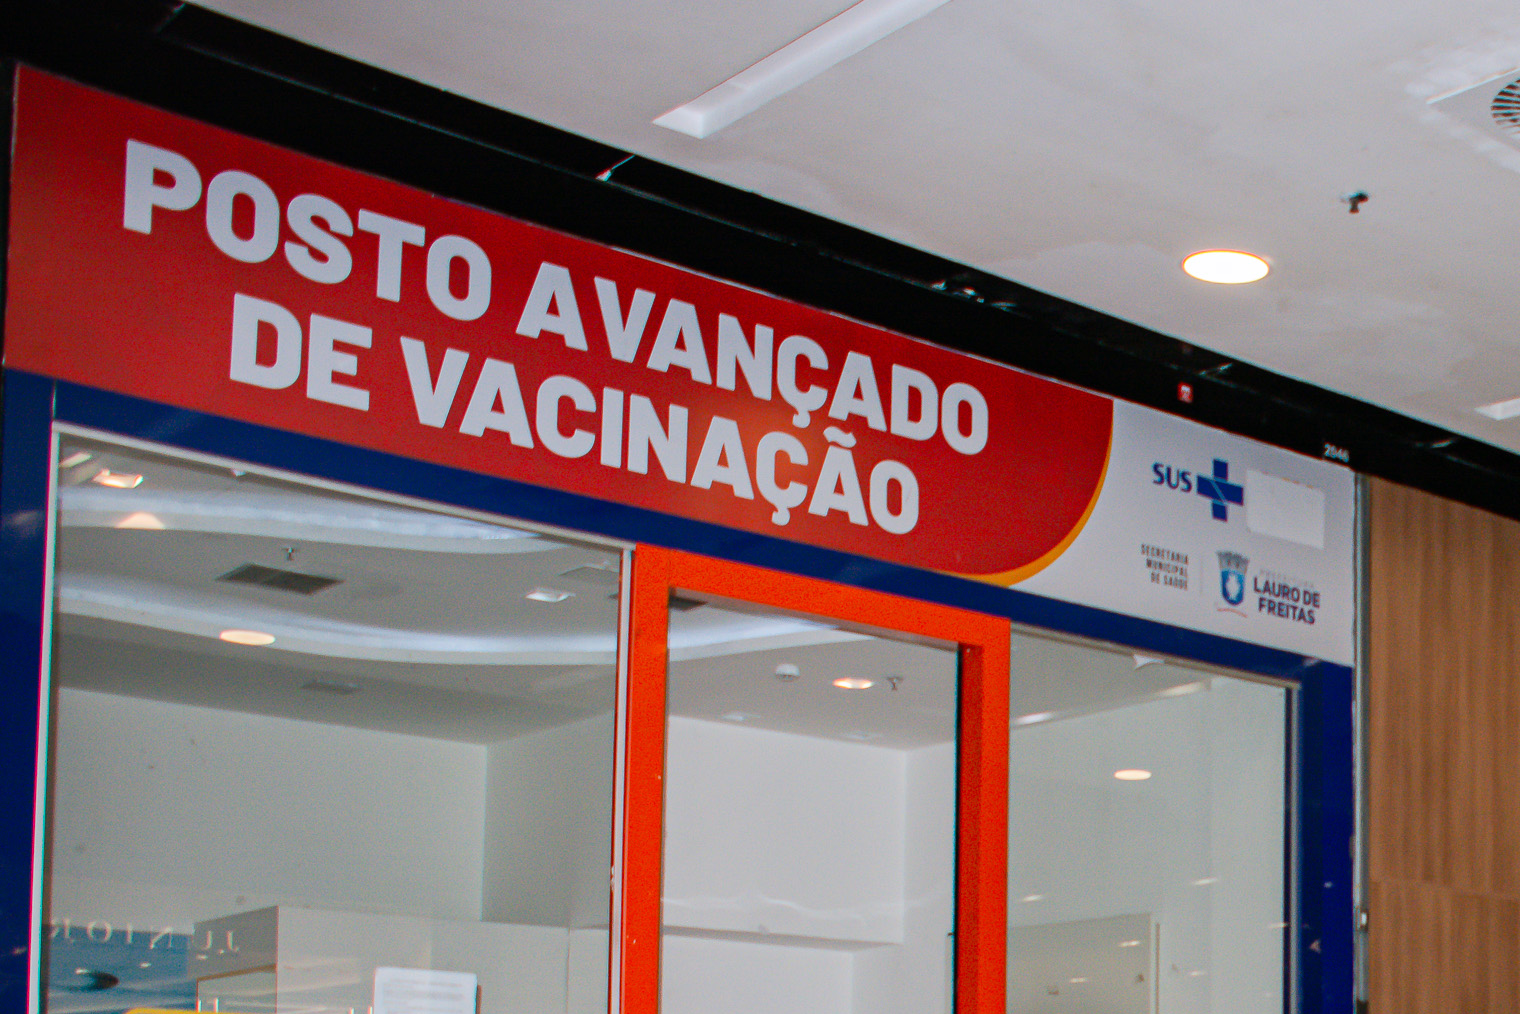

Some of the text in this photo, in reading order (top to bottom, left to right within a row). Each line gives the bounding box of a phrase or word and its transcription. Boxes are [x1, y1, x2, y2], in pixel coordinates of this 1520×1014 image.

[123, 138, 990, 456] POSTO AVANÇADO
[229, 292, 920, 535] DE VACINAÇÃO
[1152, 462, 1193, 493] SUS
[1141, 543, 1189, 565] SECRETARIA
[1146, 558, 1189, 577] MUNICIPAL
[1150, 572, 1160, 584] DE
[1253, 576, 1301, 603] LAURO
[1303, 589, 1321, 609] DE
[1258, 596, 1316, 625] FREITAS
